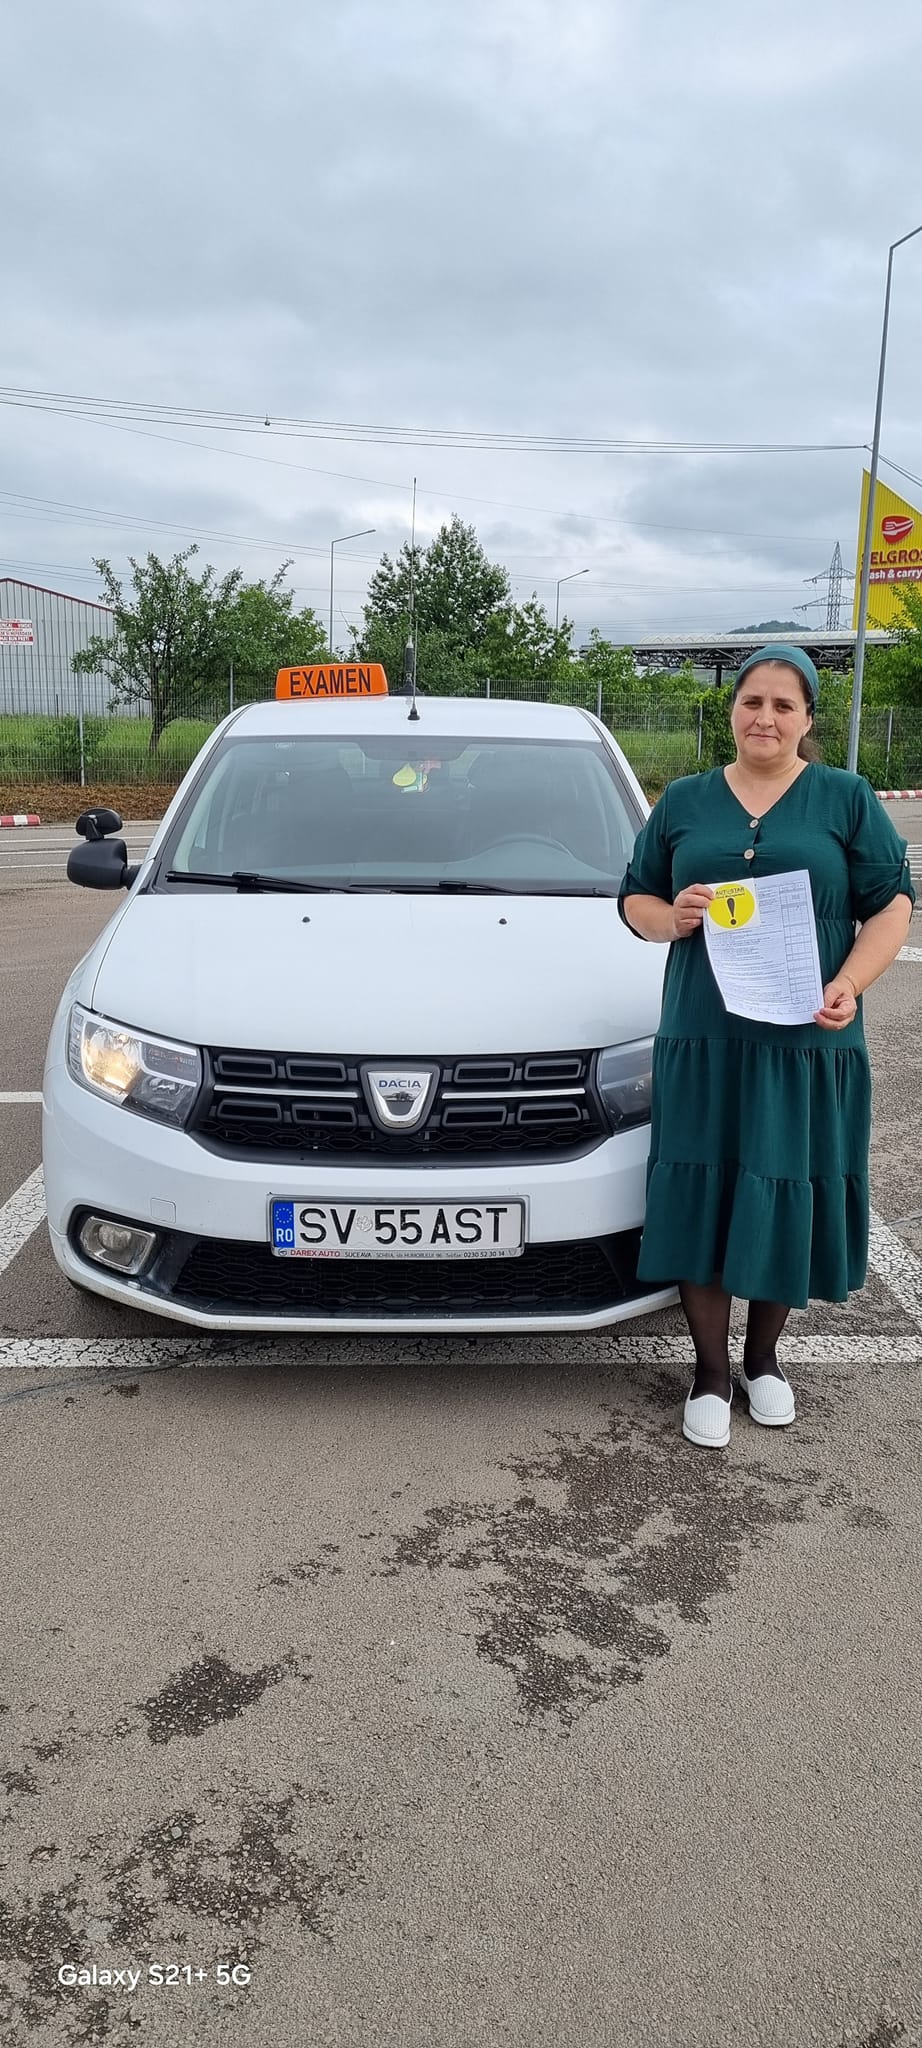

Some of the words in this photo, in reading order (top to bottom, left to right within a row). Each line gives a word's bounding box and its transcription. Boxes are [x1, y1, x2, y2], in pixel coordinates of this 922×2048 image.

[861, 549, 922, 565] ELGRO
[869, 569, 885, 579] ash
[887, 569, 896, 579] &
[896, 567, 922, 579] carry
[289, 668, 371, 696] EXAMEN
[378, 1079, 421, 1088] DACIA
[276, 1228, 294, 1243] RO
[299, 1208, 357, 1245] SV
[374, 1208, 423, 1246] 55
[429, 1207, 508, 1244] AST
[290, 1249, 318, 1257] DAREX
[318, 1250, 341, 1258] AUTO
[344, 1251, 372, 1259] SUCEAVA
